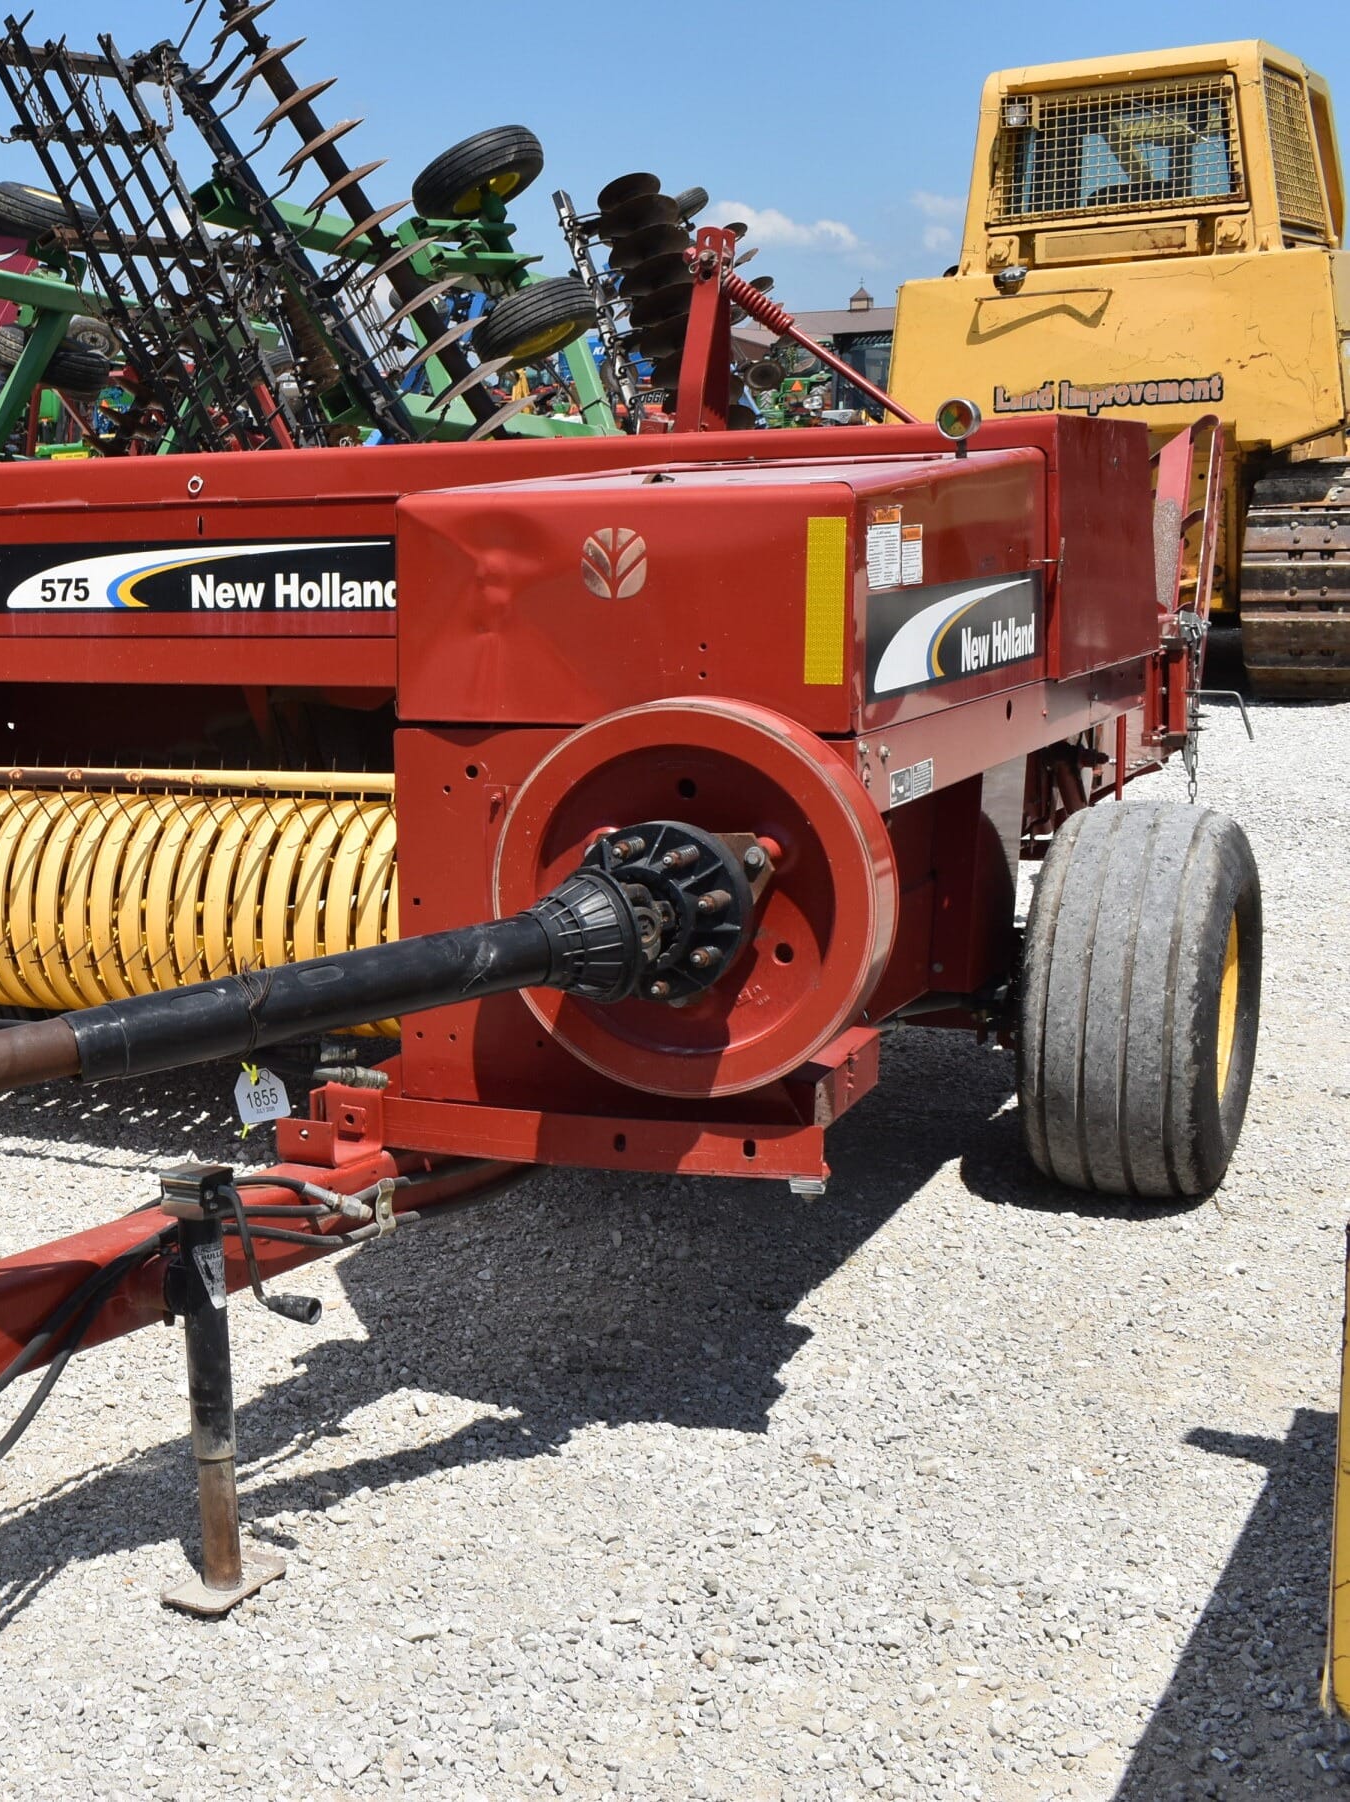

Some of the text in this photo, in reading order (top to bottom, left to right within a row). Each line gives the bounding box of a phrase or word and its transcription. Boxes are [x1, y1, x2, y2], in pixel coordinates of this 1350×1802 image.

[1058, 373, 1223, 415] Improvement
[40, 578, 90, 602] 575
[191, 574, 265, 608] New
[961, 612, 1035, 673] New Holland
[247, 1088, 279, 1109] 1855
